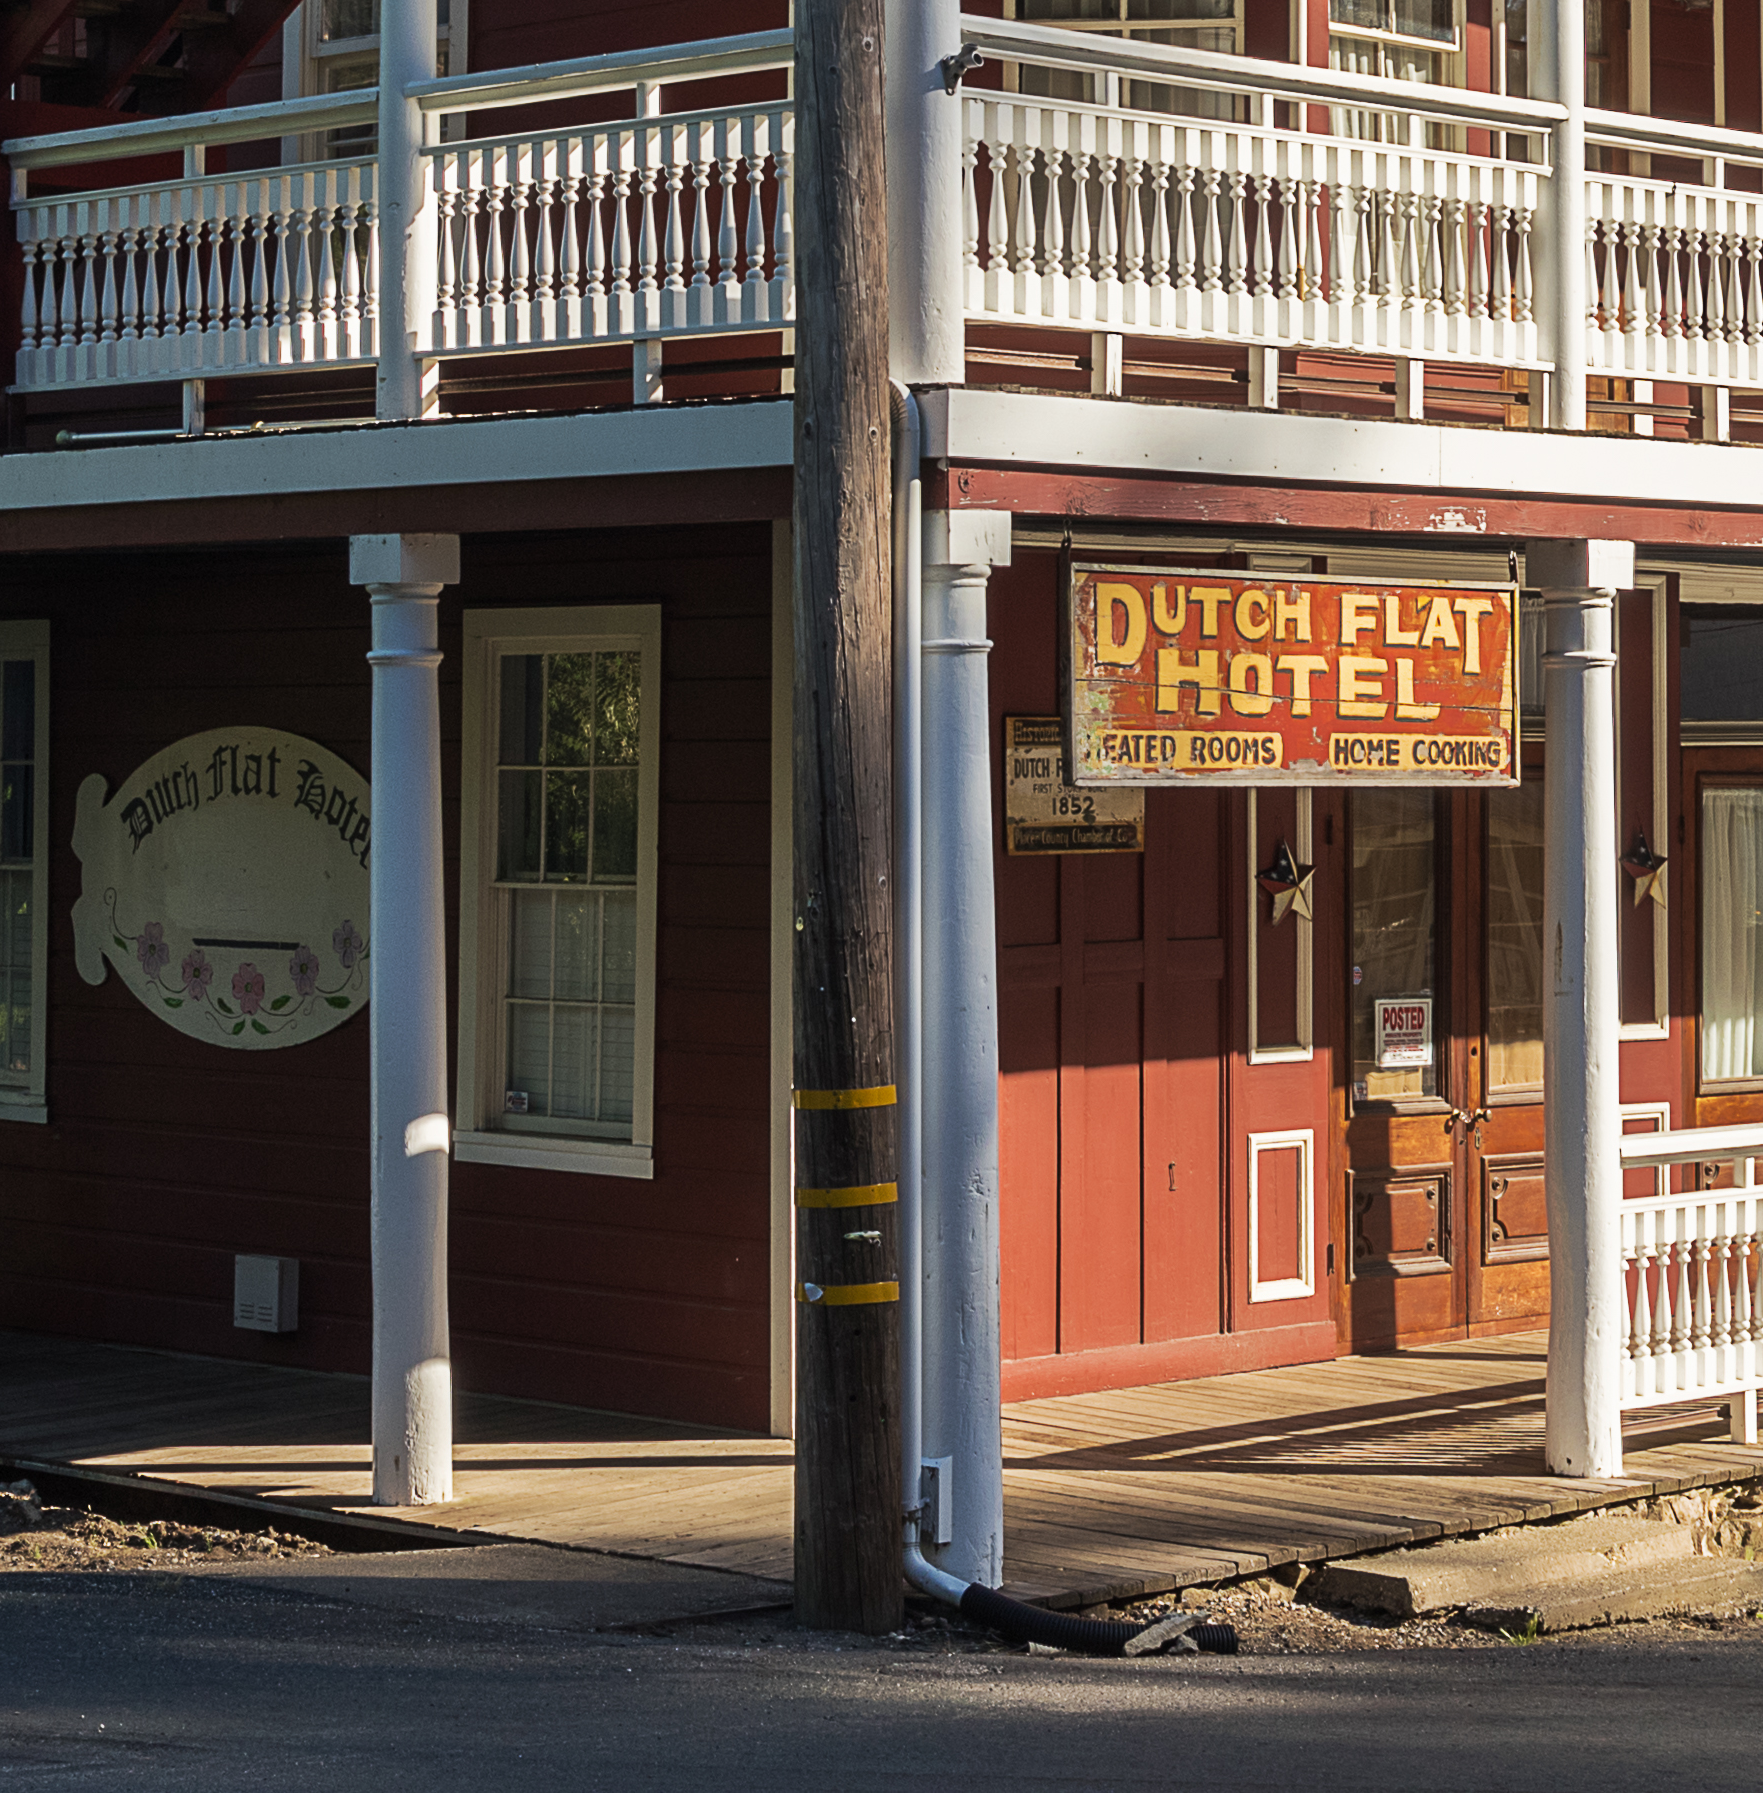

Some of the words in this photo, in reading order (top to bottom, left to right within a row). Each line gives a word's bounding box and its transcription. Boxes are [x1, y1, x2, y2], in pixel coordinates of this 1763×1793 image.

[1094, 582, 1312, 668] DUTCH
[1338, 593, 1494, 675] FLAT
[1155, 648, 1441, 722] HOTEL
[1086, 733, 1177, 765] EATED
[1191, 736, 1277, 766] ROOMS
[1335, 738, 1400, 766] HOME
[1412, 739, 1502, 768] COOKING
[1014, 758, 1050, 779] DUTCH
[1033, 783, 1053, 794] FIRST
[119, 761, 200, 855] Dutch
[1052, 796, 1096, 816] 1852
[1041, 830, 1069, 847] County
[1072, 828, 1103, 843] Chamber
[1105, 828, 1114, 843] of
[1382, 1006, 1425, 1031] POSTED
